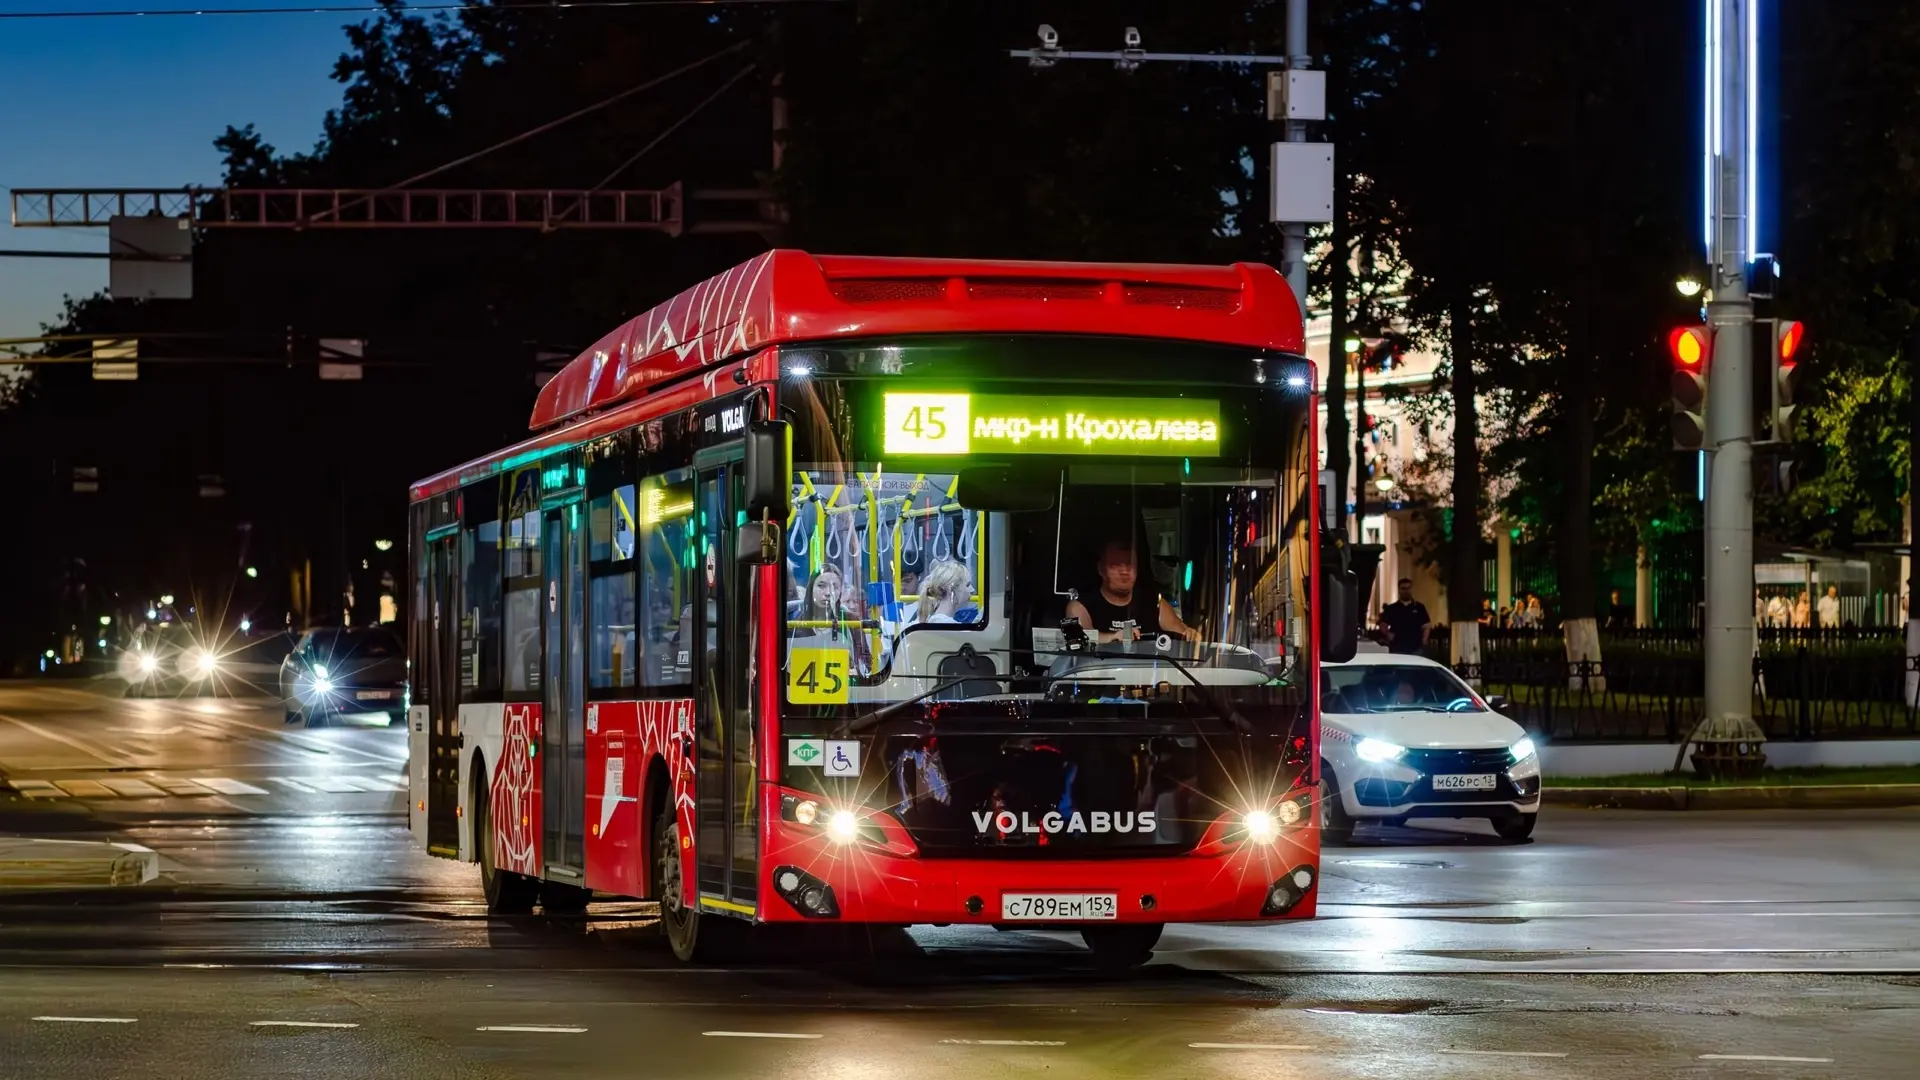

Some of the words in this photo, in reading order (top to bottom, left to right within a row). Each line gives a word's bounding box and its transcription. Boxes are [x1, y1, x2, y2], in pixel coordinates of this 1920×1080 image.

[901, 405, 947, 440] 45
[973, 414, 1058, 443] мкр-н
[1065, 412, 1217, 445] Крохалева
[900, 481, 930, 491] ВЫХОД
[796, 661, 842, 694] 45
[797, 748, 815, 757] КПГ
[971, 811, 1157, 834] VOLGABUS
[1009, 898, 1082, 916] С789ЕМ
[1085, 897, 1112, 911] 159
